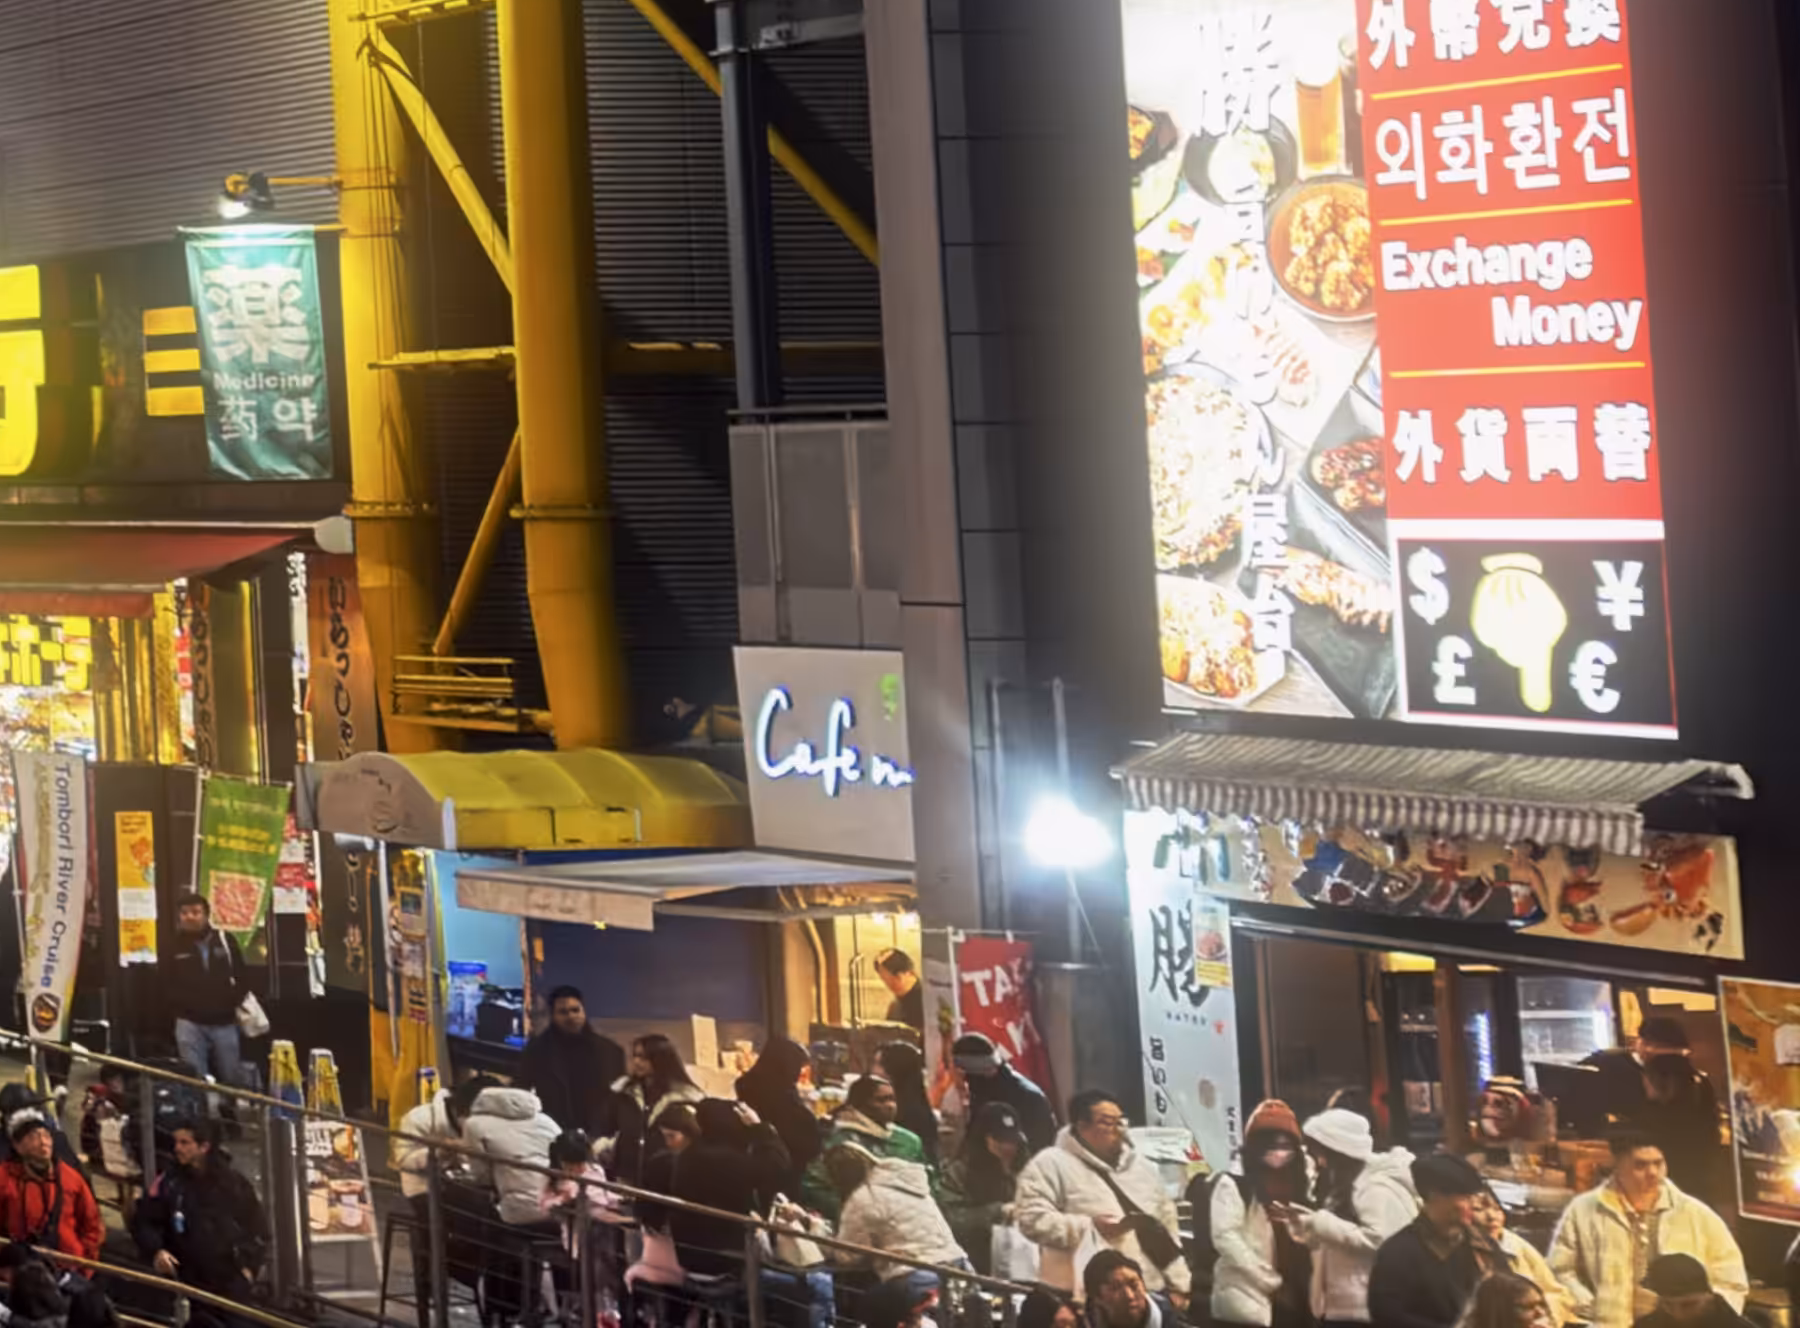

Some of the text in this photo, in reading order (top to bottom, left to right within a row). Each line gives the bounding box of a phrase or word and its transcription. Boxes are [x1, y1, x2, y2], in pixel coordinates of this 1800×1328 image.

[1374, 87, 1633, 201] 외화환전
[1380, 236, 1594, 291] Exchange
[1490, 295, 1644, 353] Money
[212, 370, 316, 392] Medicine
[1391, 401, 1652, 485] 外貨両替
[1407, 545, 1645, 632] $ ¥
[1431, 635, 1621, 714] £ €
[754, 687, 864, 797] Cafe
